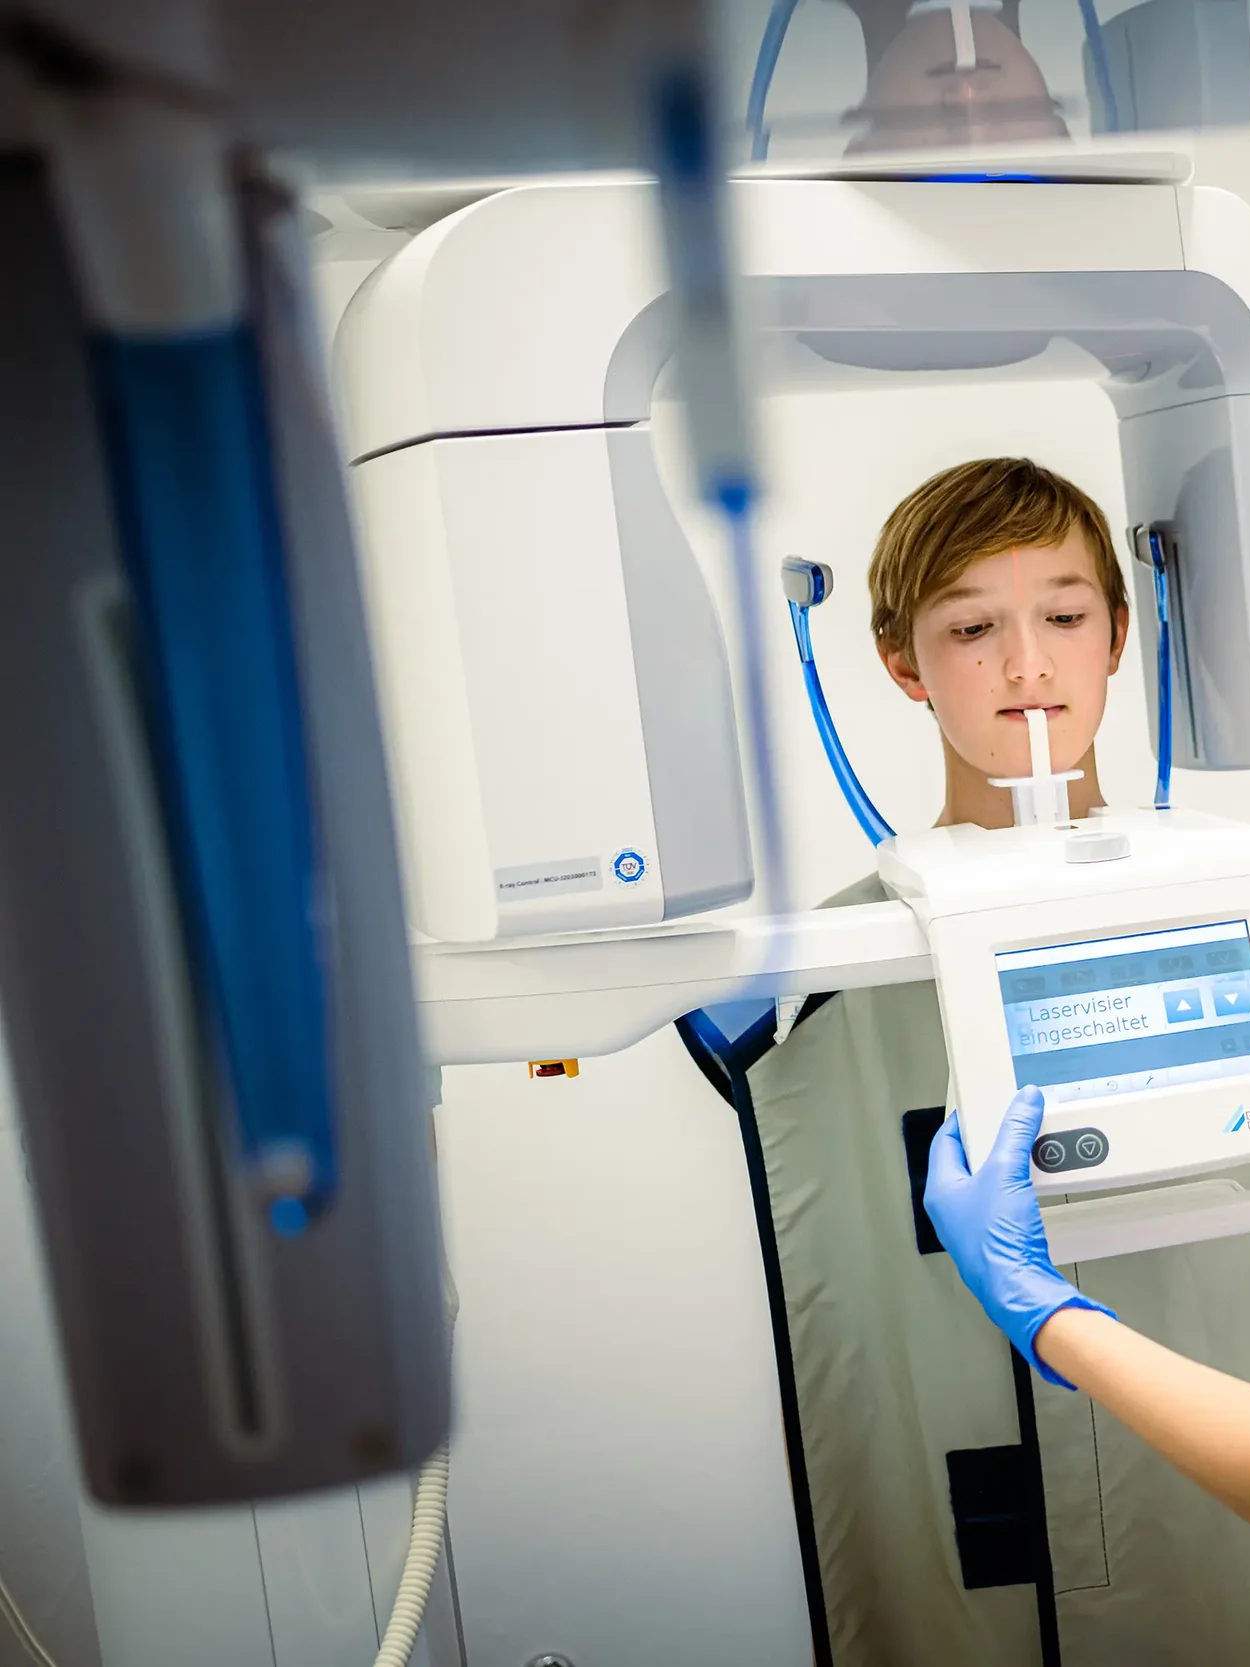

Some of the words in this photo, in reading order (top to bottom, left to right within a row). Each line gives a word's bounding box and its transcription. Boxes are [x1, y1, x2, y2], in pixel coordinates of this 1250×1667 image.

[516, 878, 539, 887] Control
[1029, 996, 1131, 1022] Laservisier
[1020, 1014, 1149, 1046] eingeschaltet
